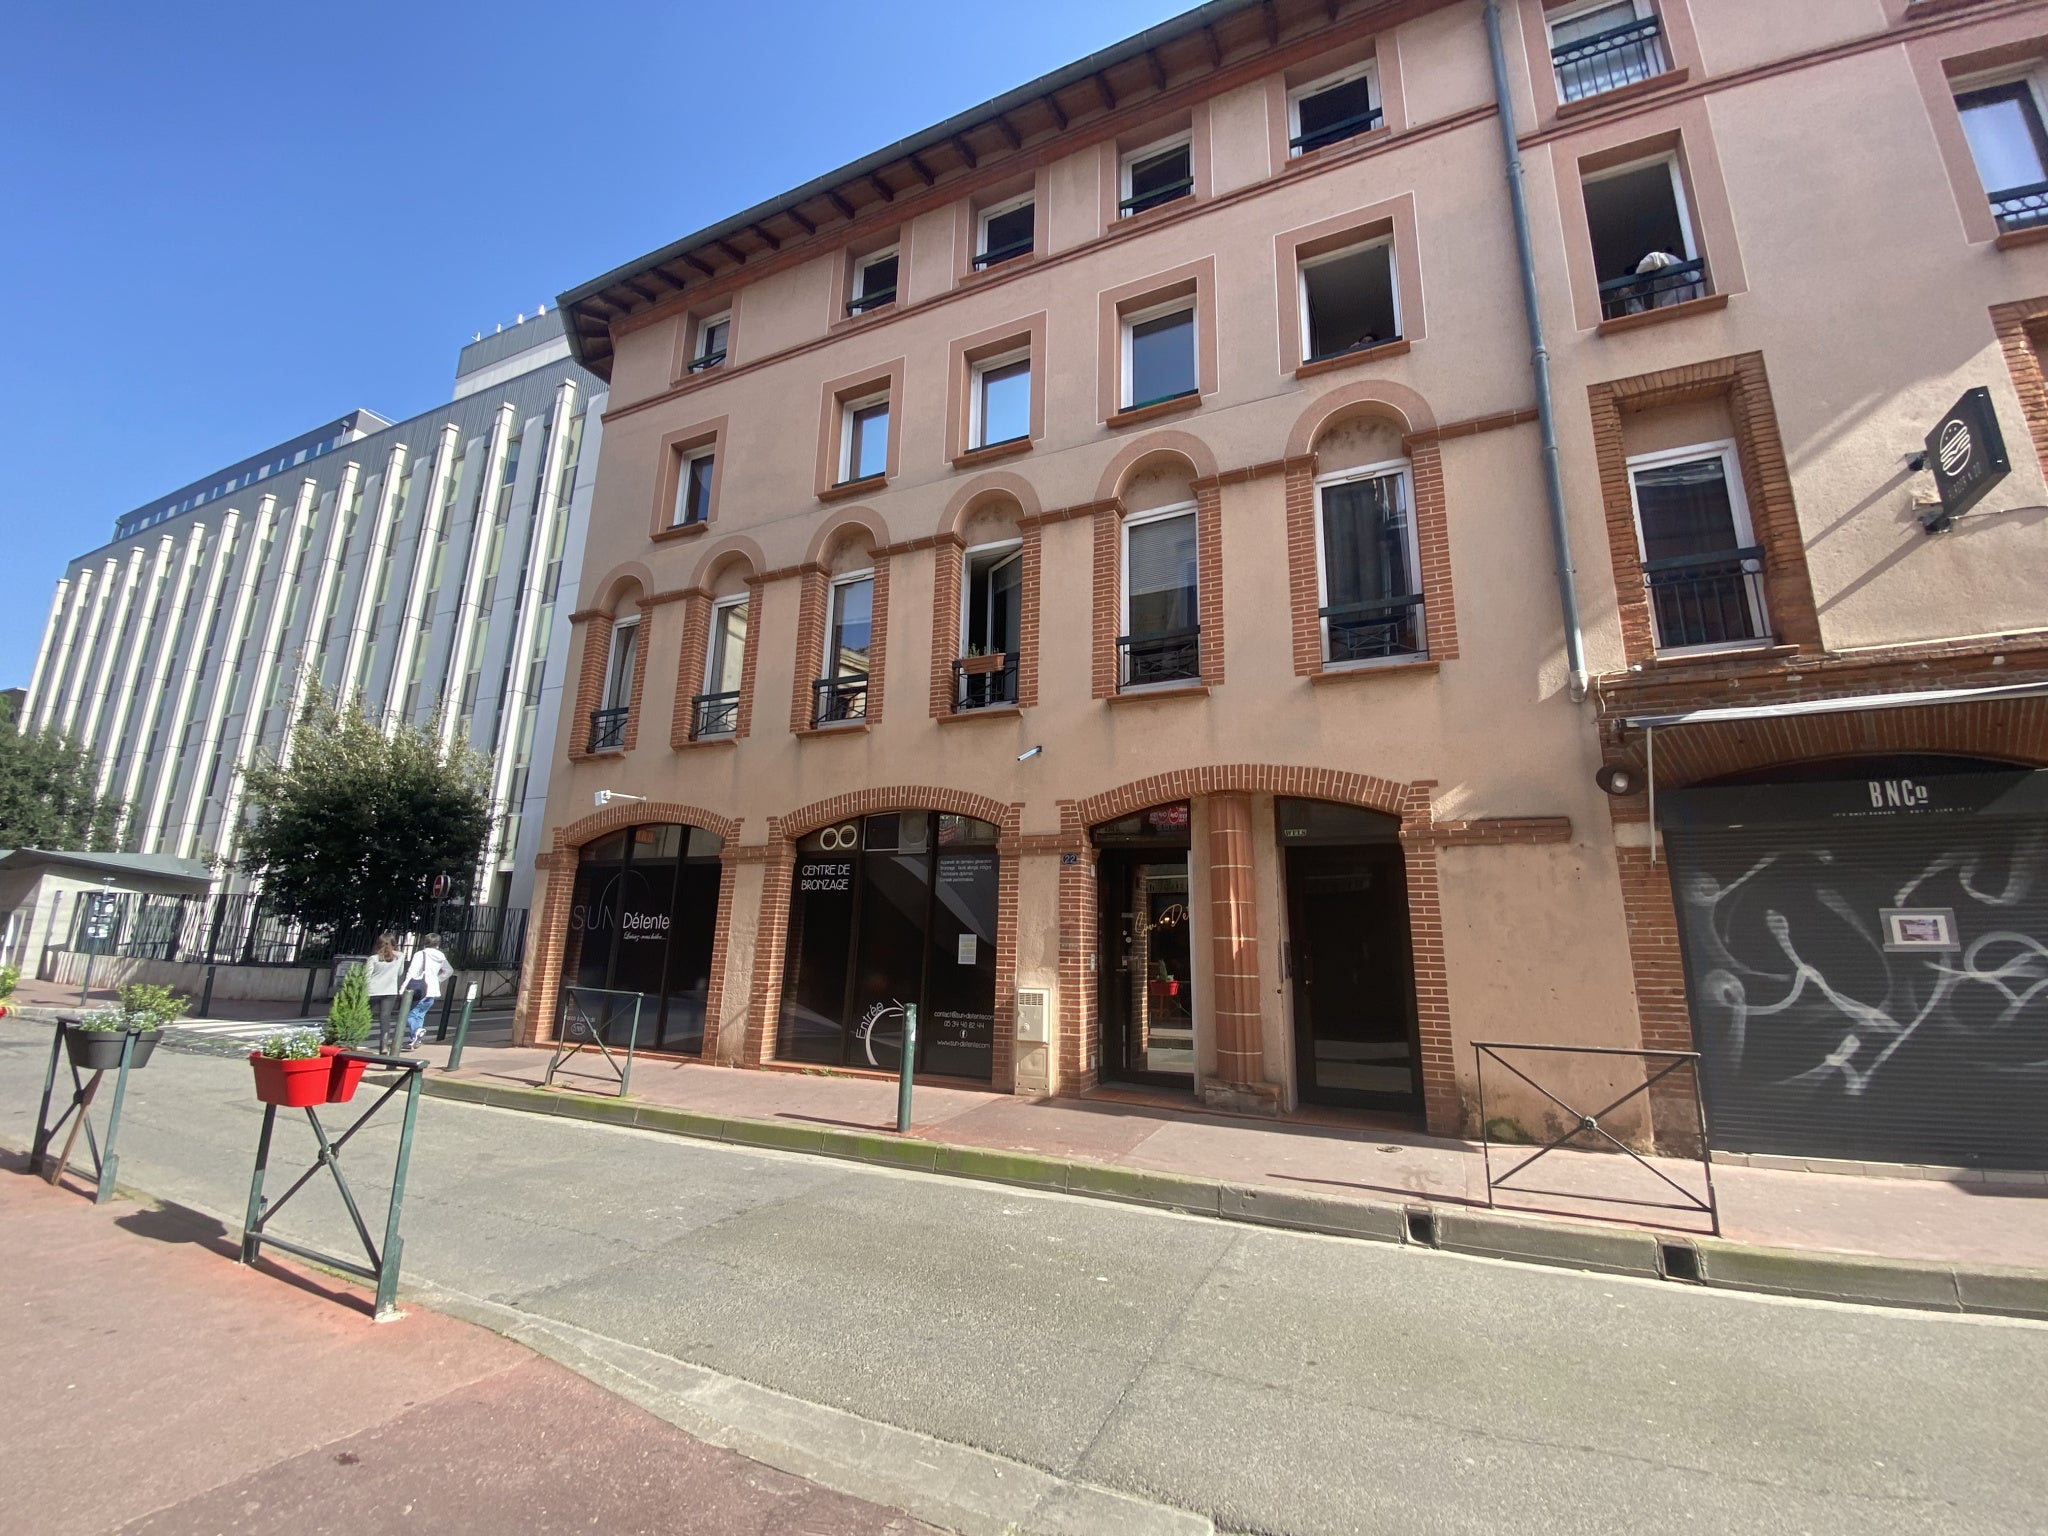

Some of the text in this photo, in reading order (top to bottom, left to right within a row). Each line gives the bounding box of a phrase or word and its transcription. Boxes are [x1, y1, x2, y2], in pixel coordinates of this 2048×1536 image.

[1868, 779, 1929, 808] BNCo
[802, 864, 851, 876] CENTRE DE
[801, 879, 849, 891] BRONZAGE
[622, 911, 670, 930] Détente
[855, 1002, 884, 1039] Entrée
